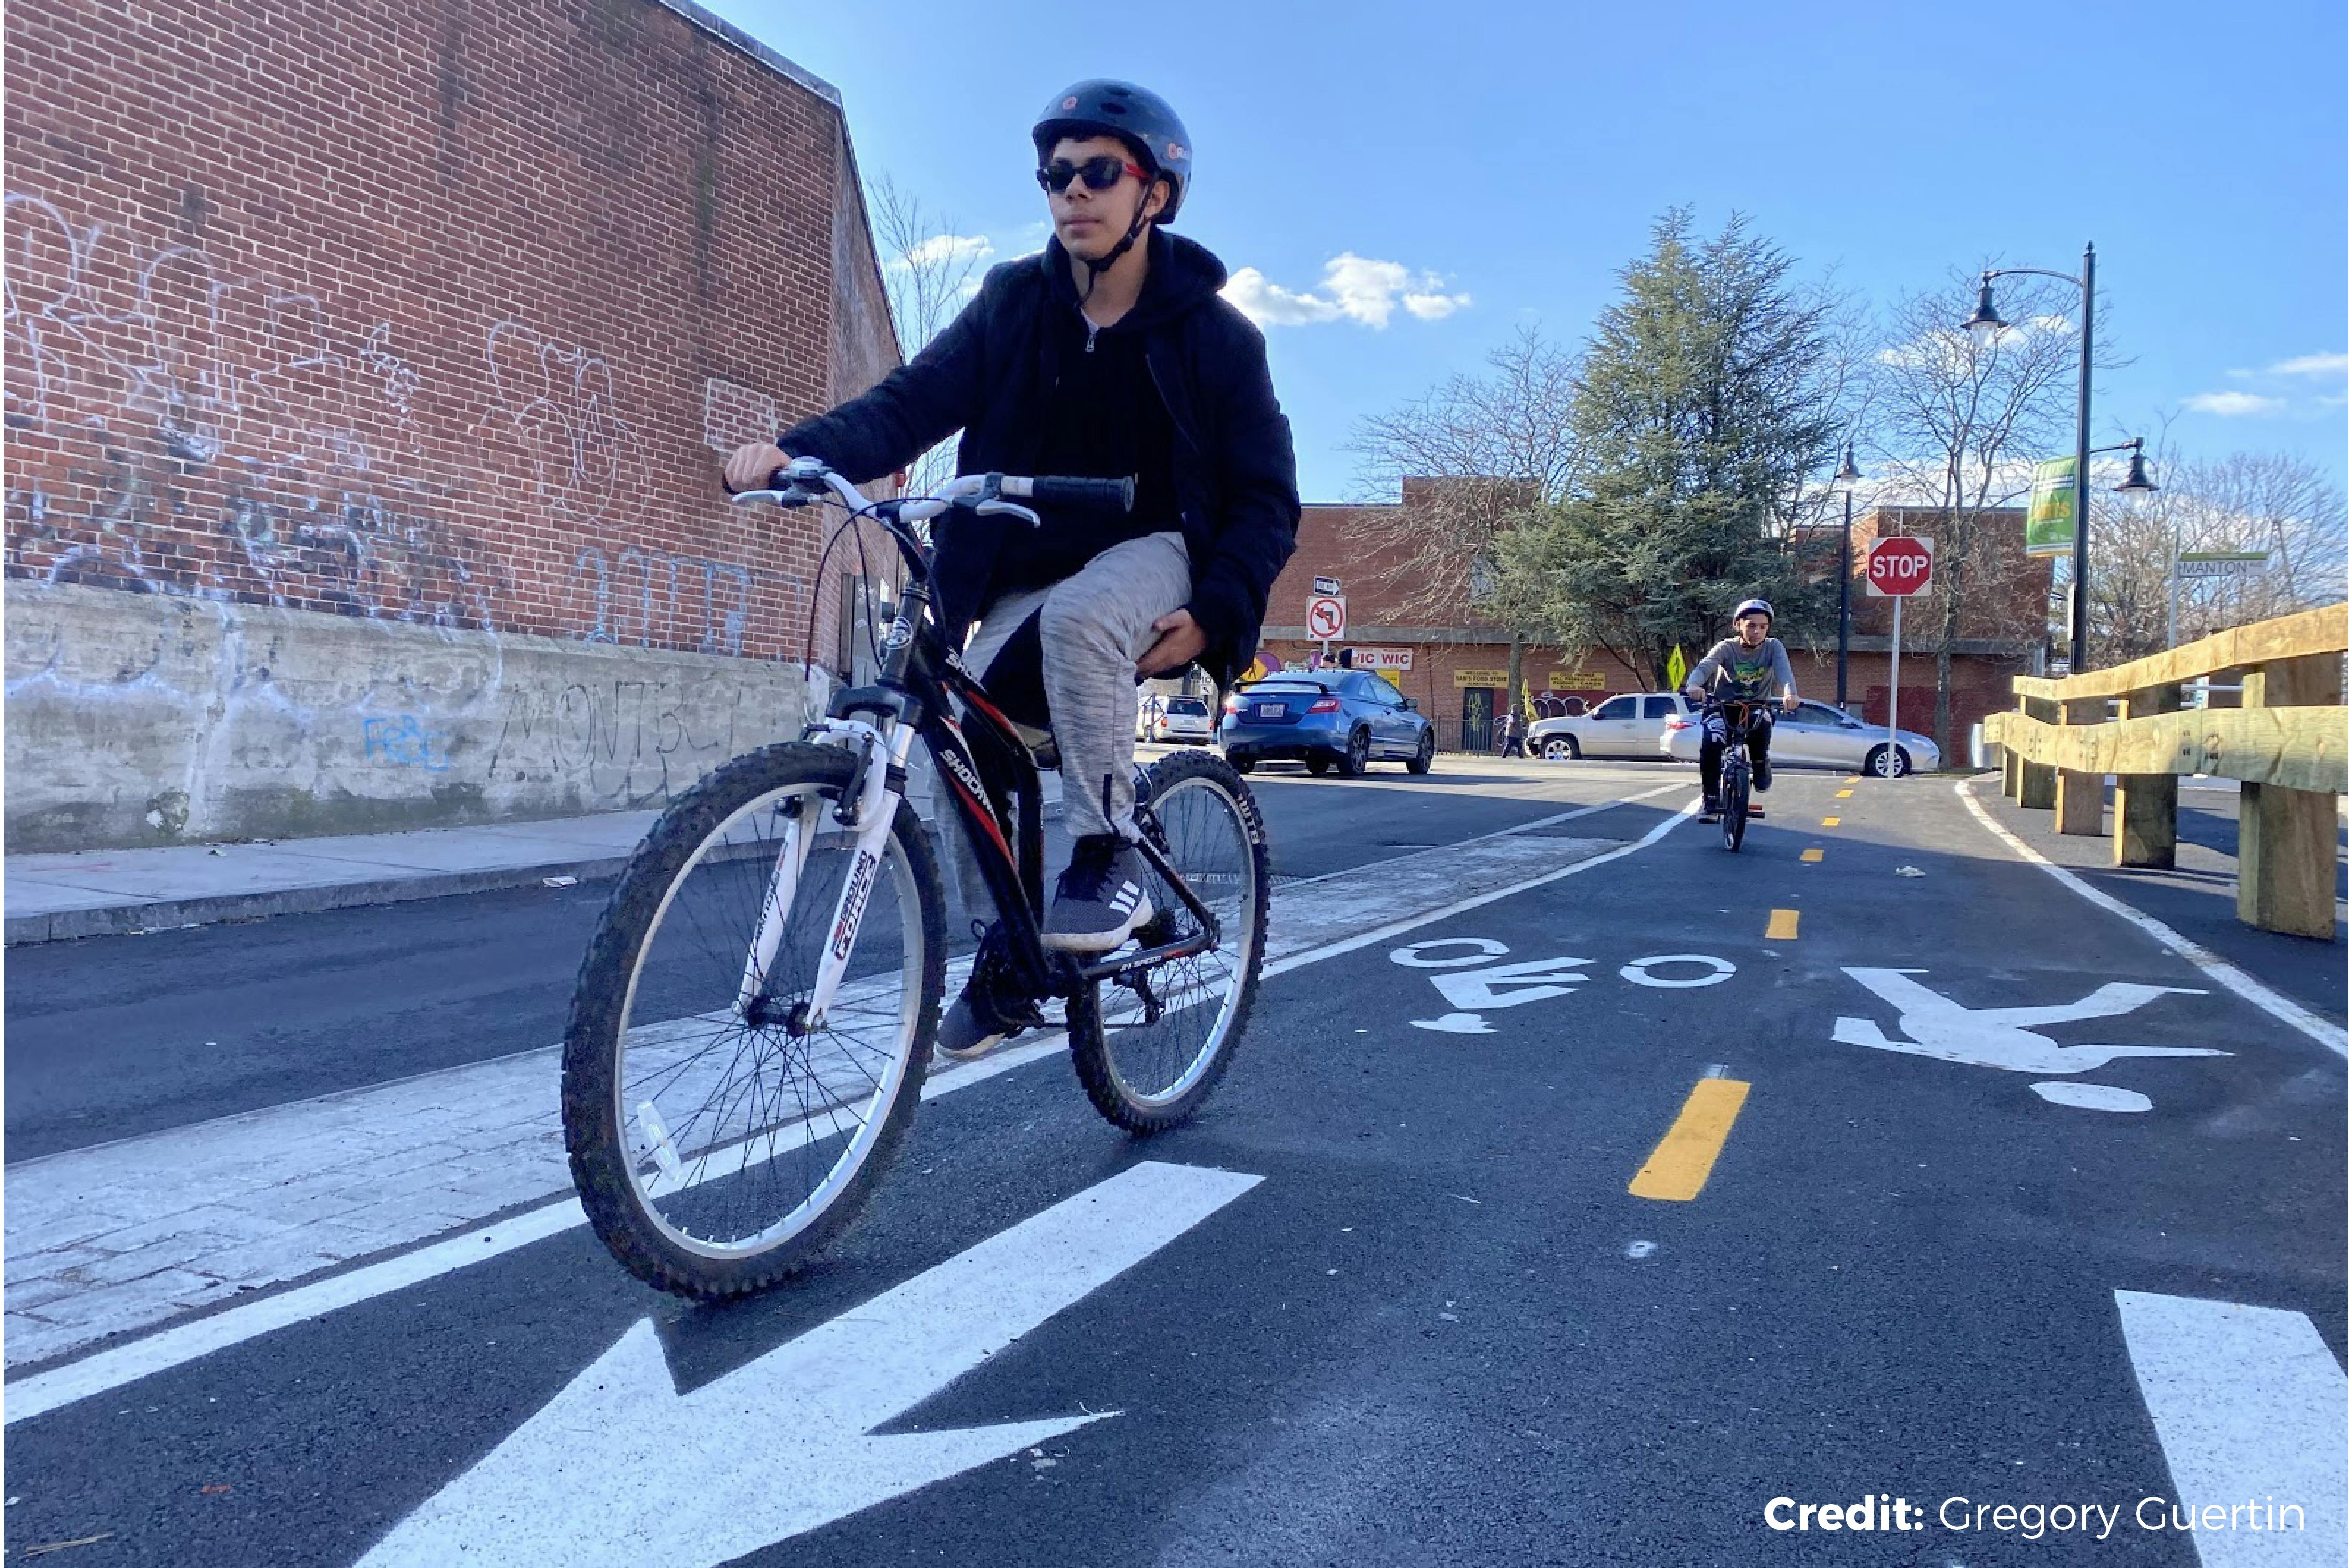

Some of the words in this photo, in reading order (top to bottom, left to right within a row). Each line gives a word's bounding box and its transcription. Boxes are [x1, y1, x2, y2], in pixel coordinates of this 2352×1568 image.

[1873, 555, 1928, 578] STOP
[2183, 561, 2246, 573] MANTON
[1382, 653, 1410, 664] WIC
